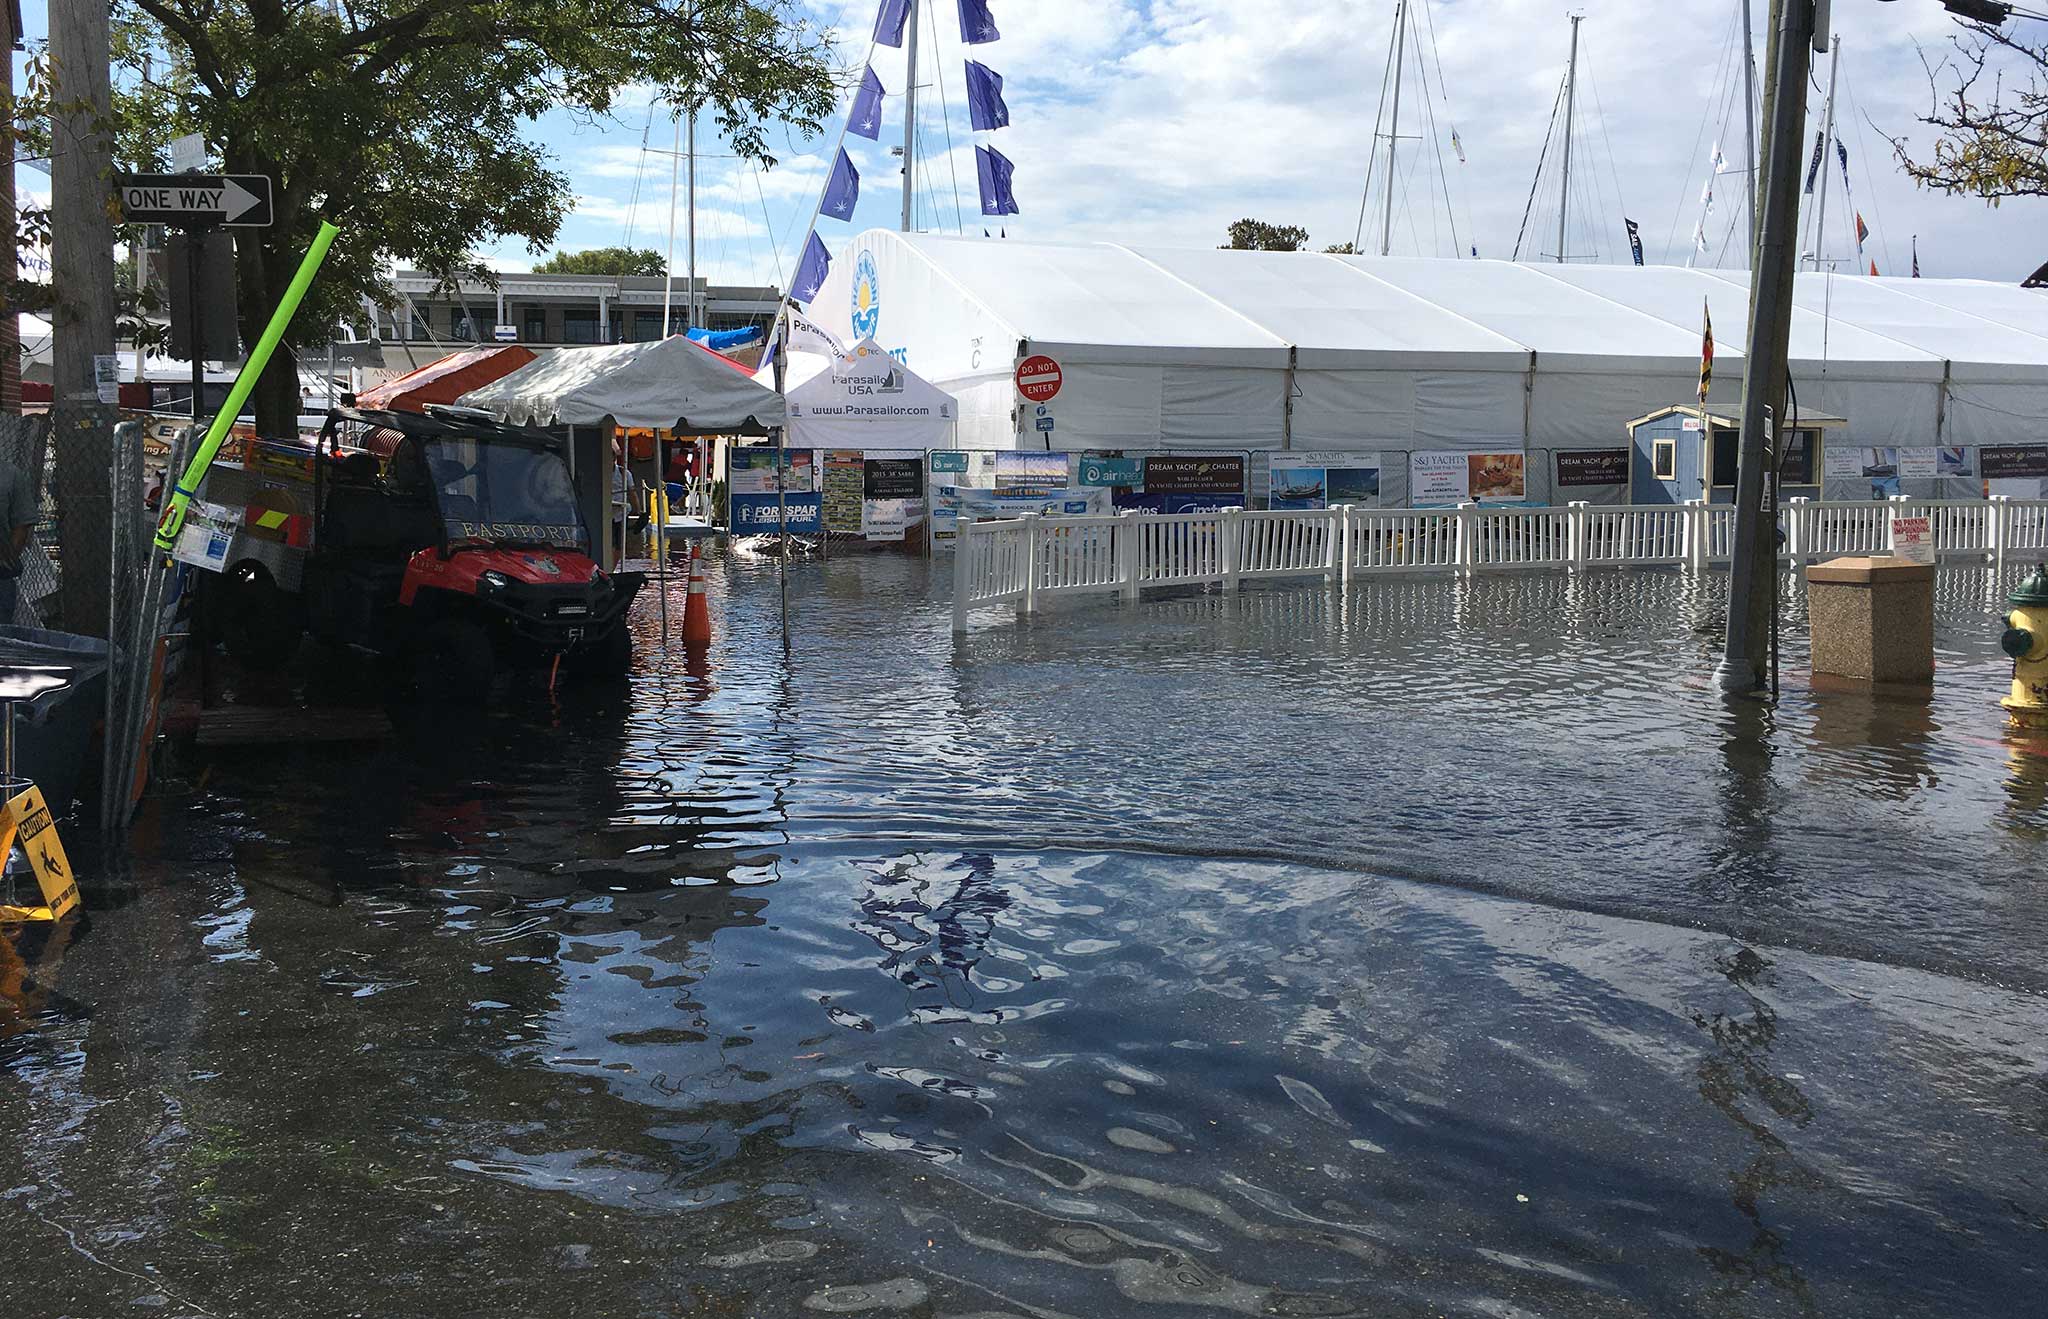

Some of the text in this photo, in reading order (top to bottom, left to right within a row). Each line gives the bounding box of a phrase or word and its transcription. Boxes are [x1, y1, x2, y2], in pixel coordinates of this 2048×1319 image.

[129, 189, 223, 208] ONE WAY
[794, 320, 845, 360] Parasailor
[1022, 362, 1054, 374] DO NOT
[848, 386, 873, 395] USA
[1028, 384, 1054, 394] ENTER
[812, 405, 929, 416] www.Parasailor.com
[1431, 455, 1466, 465] YACHTS
[1149, 463, 1239, 471] DREAM YACHT CHARTER
[755, 504, 817, 517] FORSPAR
[754, 515, 814, 524] LEISUE FURL
[1903, 518, 1928, 526] PARKING
[462, 522, 573, 541] EASTPORT
[1906, 534, 1920, 542] ZONE
[21, 810, 50, 839] CAUTION
